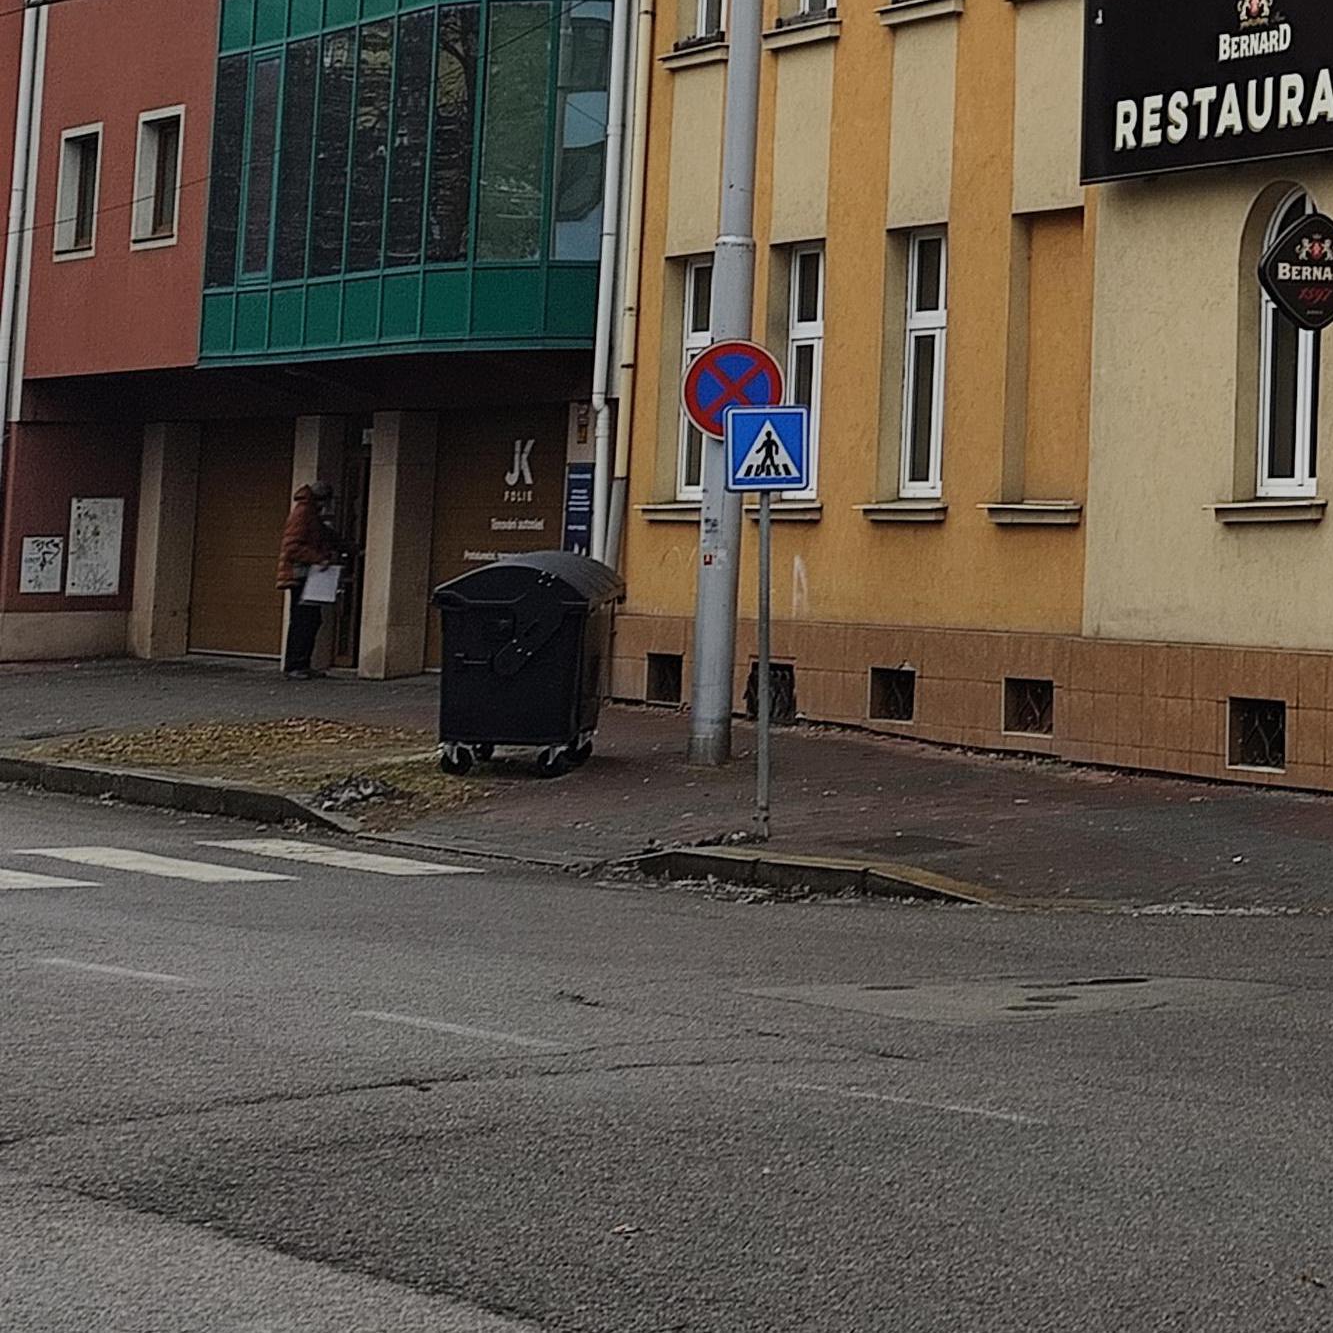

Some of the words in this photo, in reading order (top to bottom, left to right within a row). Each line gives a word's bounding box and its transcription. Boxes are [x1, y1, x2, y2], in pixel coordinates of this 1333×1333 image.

[1218, 23, 1292, 62] BERNARD
[505, 439, 535, 486] JK
[503, 490, 533, 502] FOLIE
